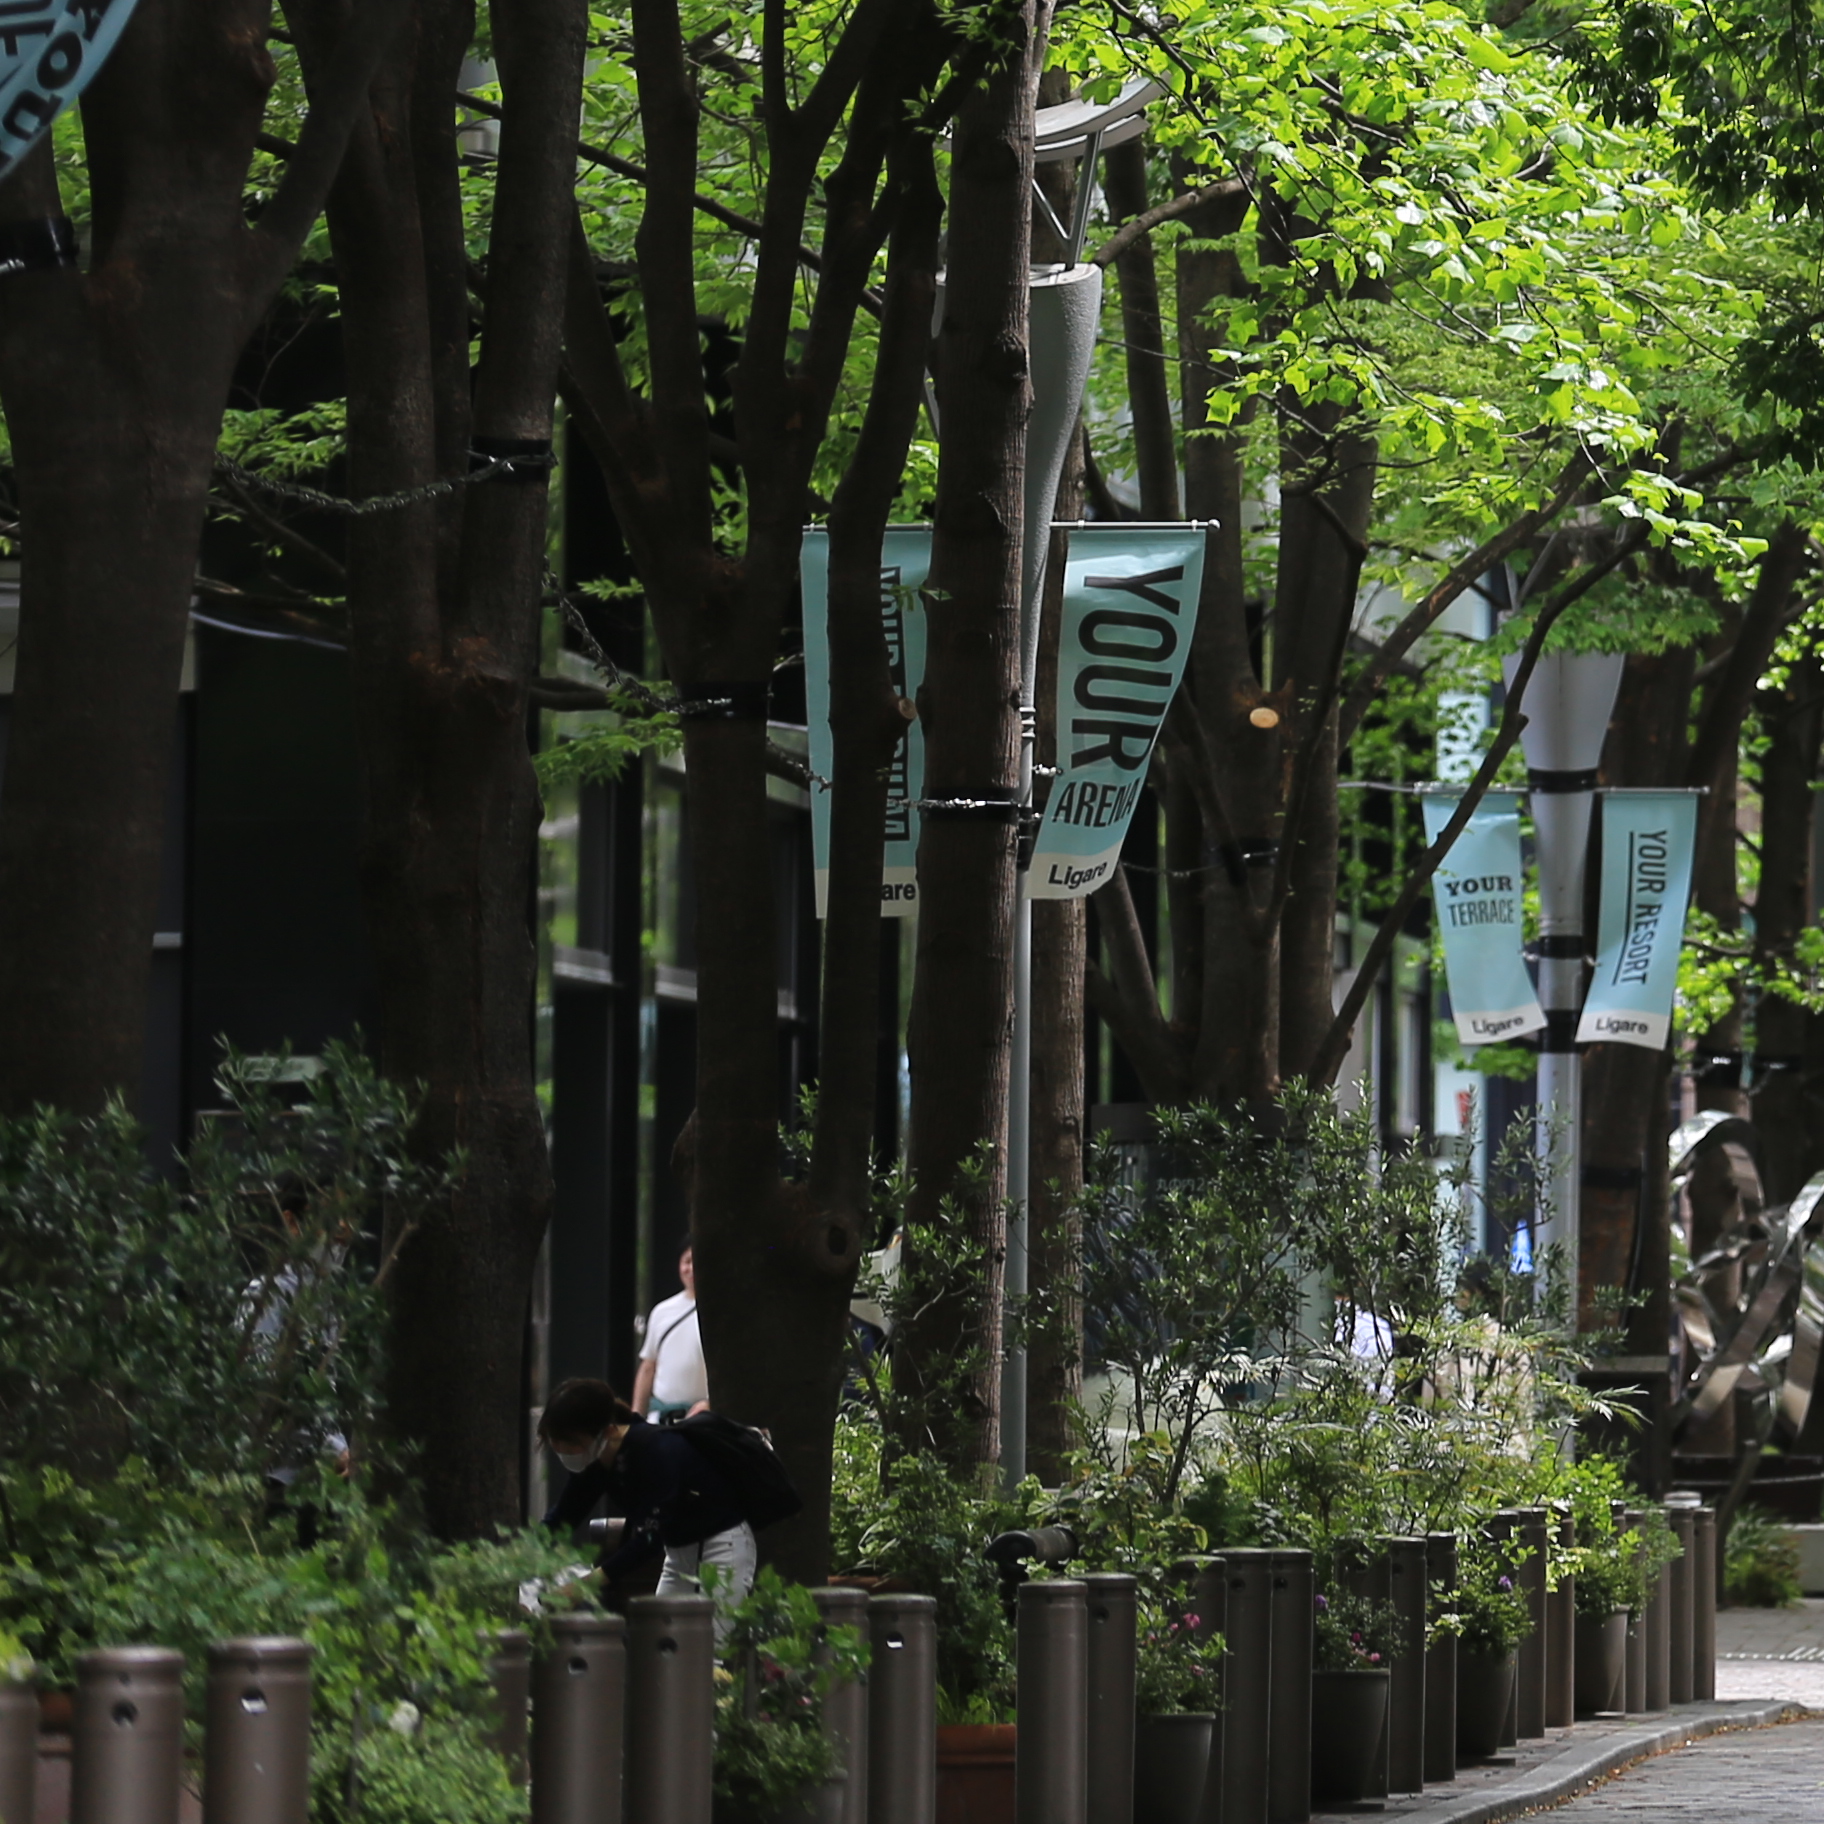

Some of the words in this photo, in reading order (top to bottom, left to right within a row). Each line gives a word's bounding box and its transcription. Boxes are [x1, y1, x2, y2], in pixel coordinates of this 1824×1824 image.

[1071, 565, 1185, 771] YOUR
[1052, 778, 1140, 828] ARENA
[1048, 860, 1108, 890] Ligare
[1637, 829, 1668, 895] YOUR
[1444, 875, 1513, 897] YOUR
[1447, 899, 1515, 928] TERRACE
[1621, 903, 1663, 985] RESORT
[1471, 1016, 1525, 1037] Ligare
[1595, 1018, 1649, 1036] Ligare
